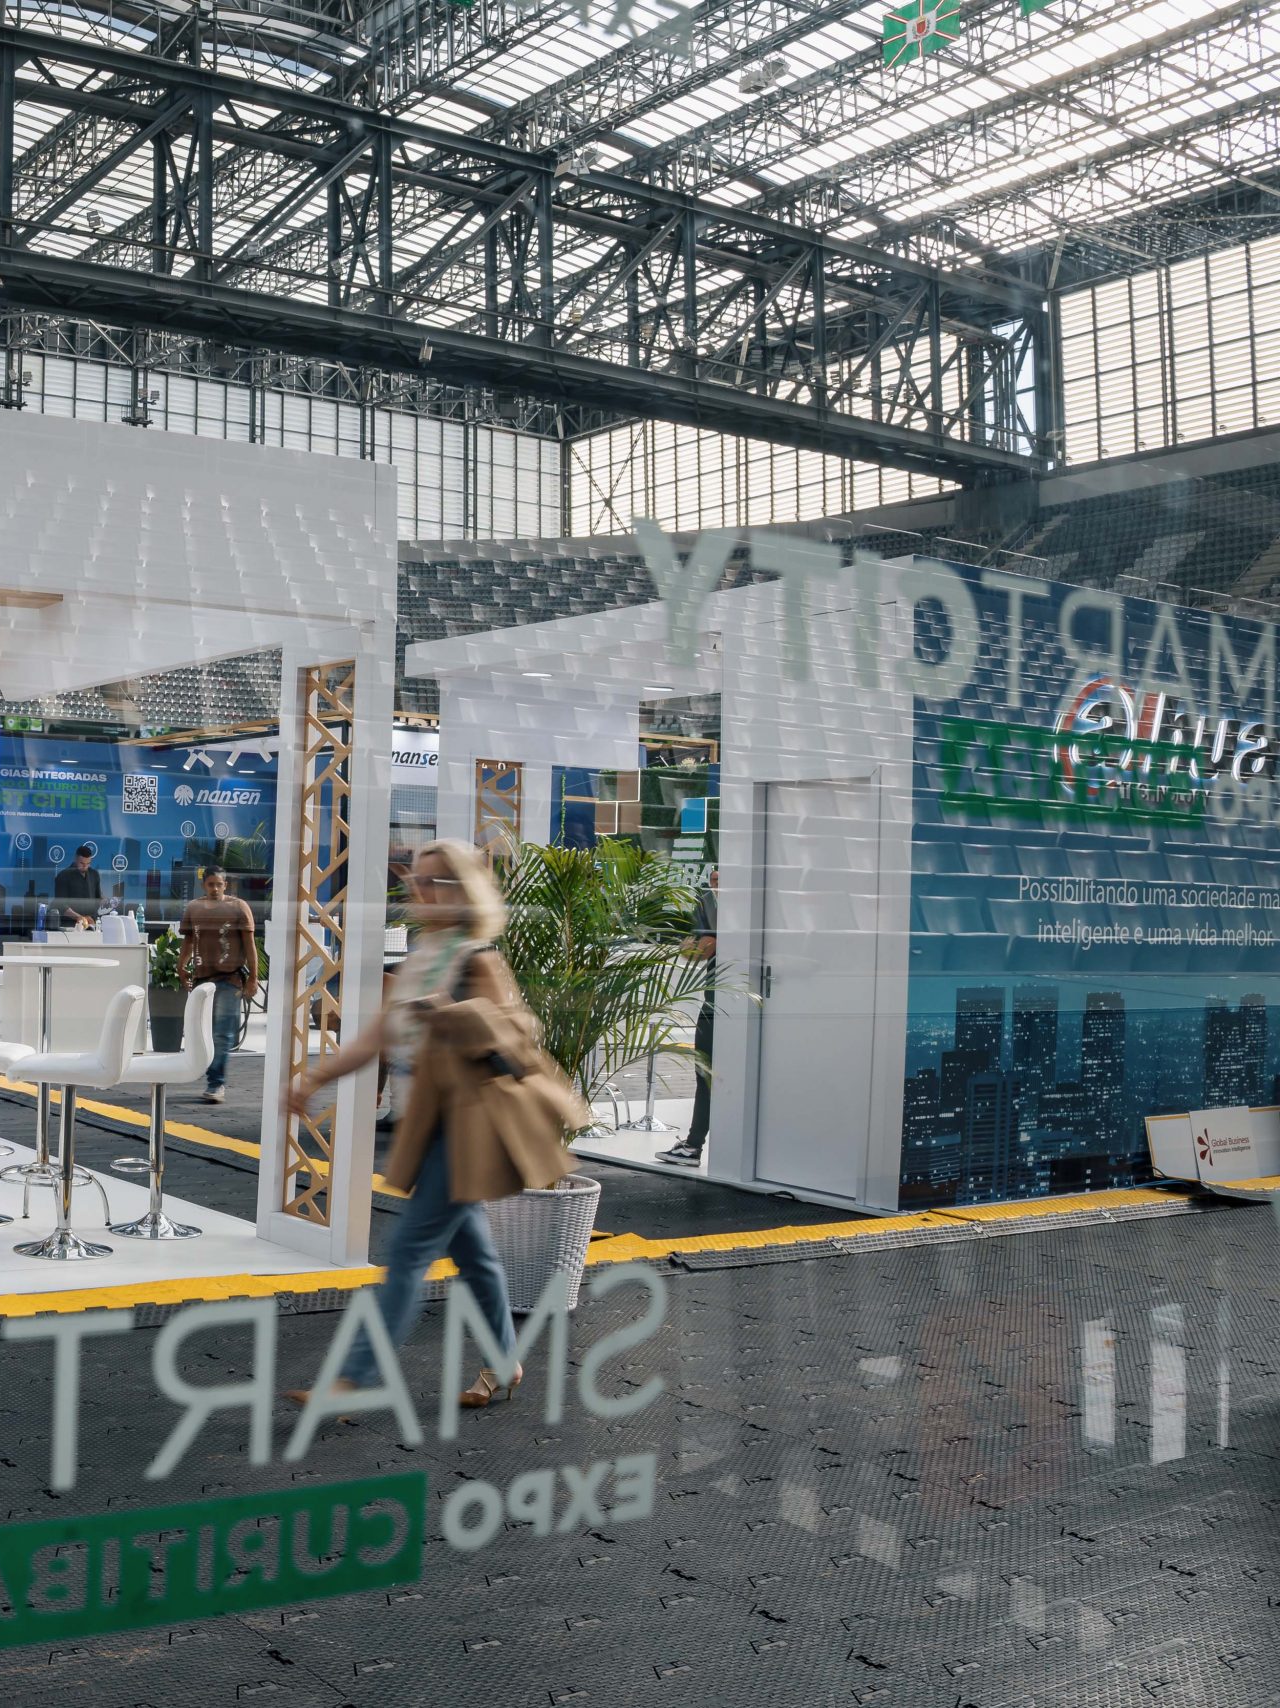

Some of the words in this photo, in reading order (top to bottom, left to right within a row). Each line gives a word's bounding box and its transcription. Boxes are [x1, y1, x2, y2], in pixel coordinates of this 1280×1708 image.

[392, 750, 440, 766] nanse
[31, 771, 108, 782] INTEGRADAS
[31, 781, 79, 791] FUTURO
[81, 784, 106, 792] DAS
[32, 792, 107, 811] CITIES
[196, 788, 262, 806] nansen
[1019, 876, 1138, 905] Possibilitando
[1143, 888, 1177, 905] uma
[1181, 885, 1255, 909] sociedade
[1037, 917, 1129, 951] inteligente
[1133, 927, 1144, 945] e
[1148, 927, 1182, 947] uma
[1185, 922, 1217, 947] vida
[1221, 922, 1275, 948] melhor.
[1211, 1138, 1228, 1148] Global
[1228, 1136, 1250, 1146] Business
